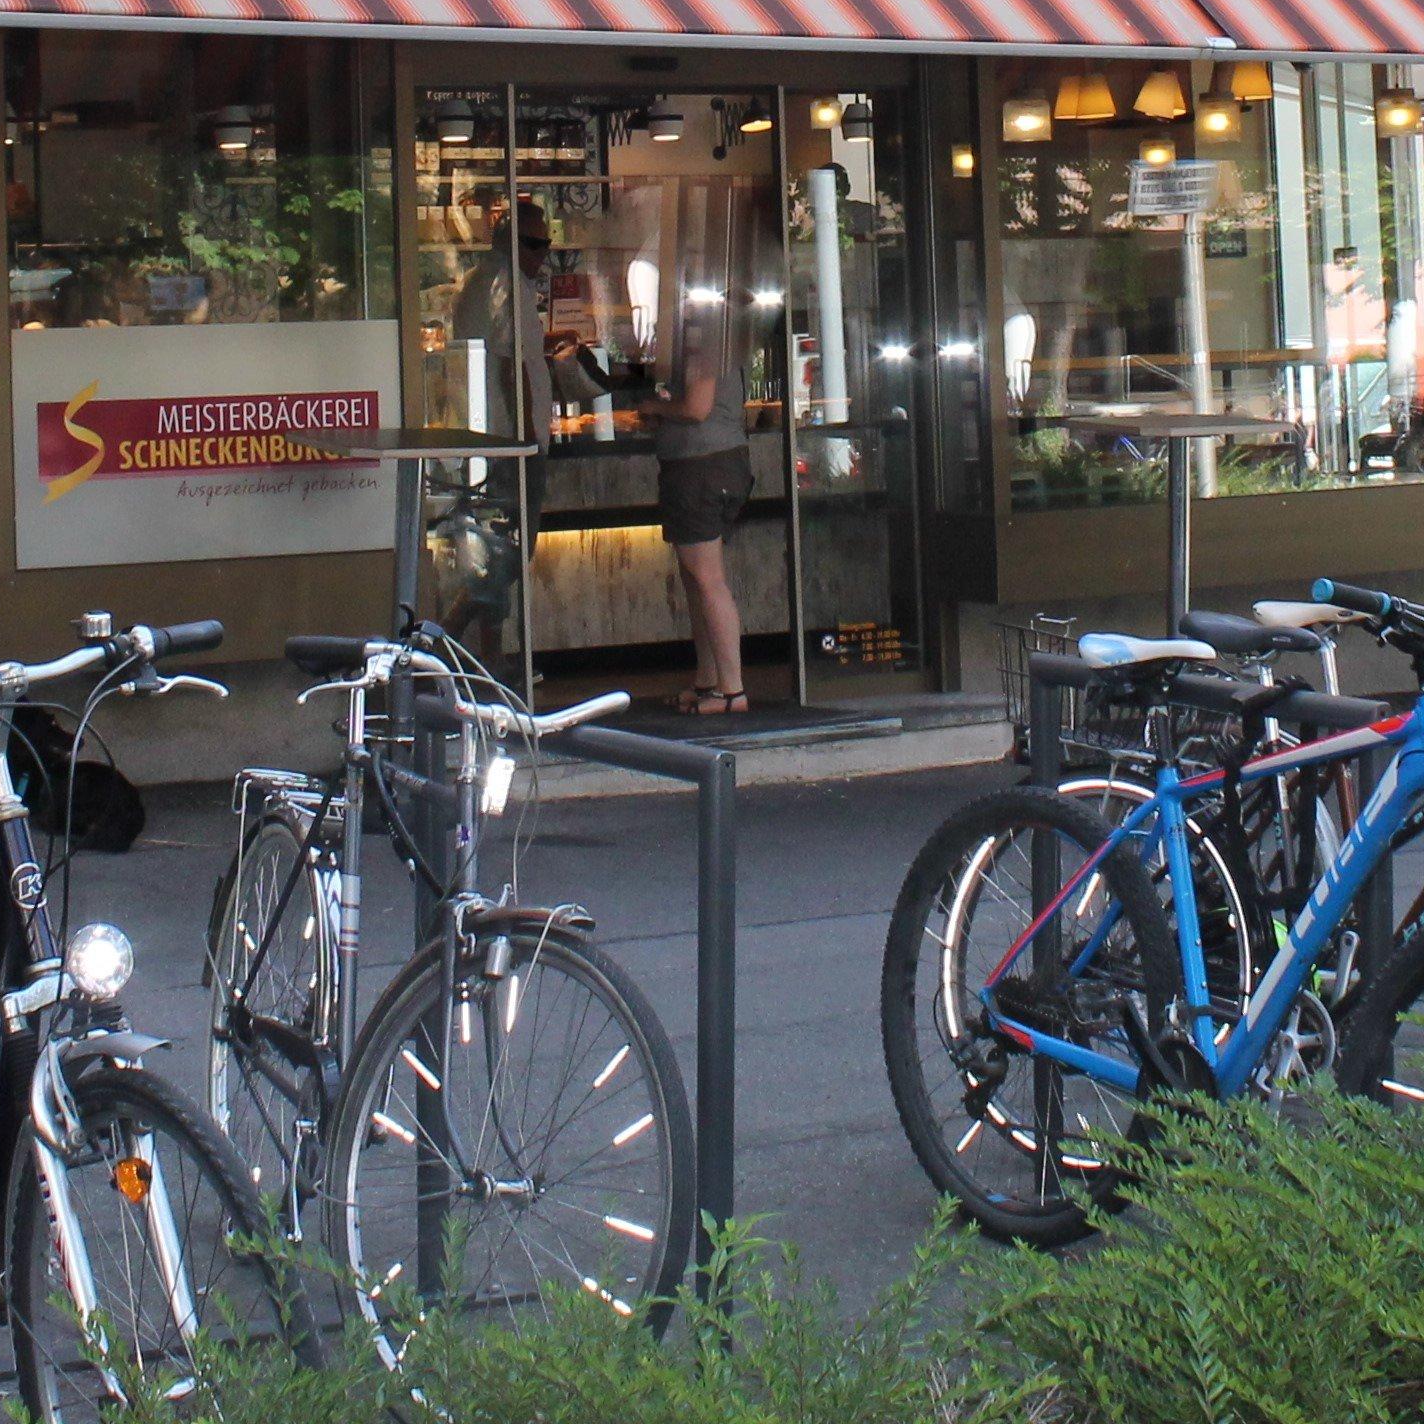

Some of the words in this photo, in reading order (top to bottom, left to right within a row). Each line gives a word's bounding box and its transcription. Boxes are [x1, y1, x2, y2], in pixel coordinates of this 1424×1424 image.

[158, 396, 370, 435] MEISTERBÄCKEREI
[119, 432, 348, 471] SCHNECKENBU
[177, 476, 294, 506] Ausgezeichnet
